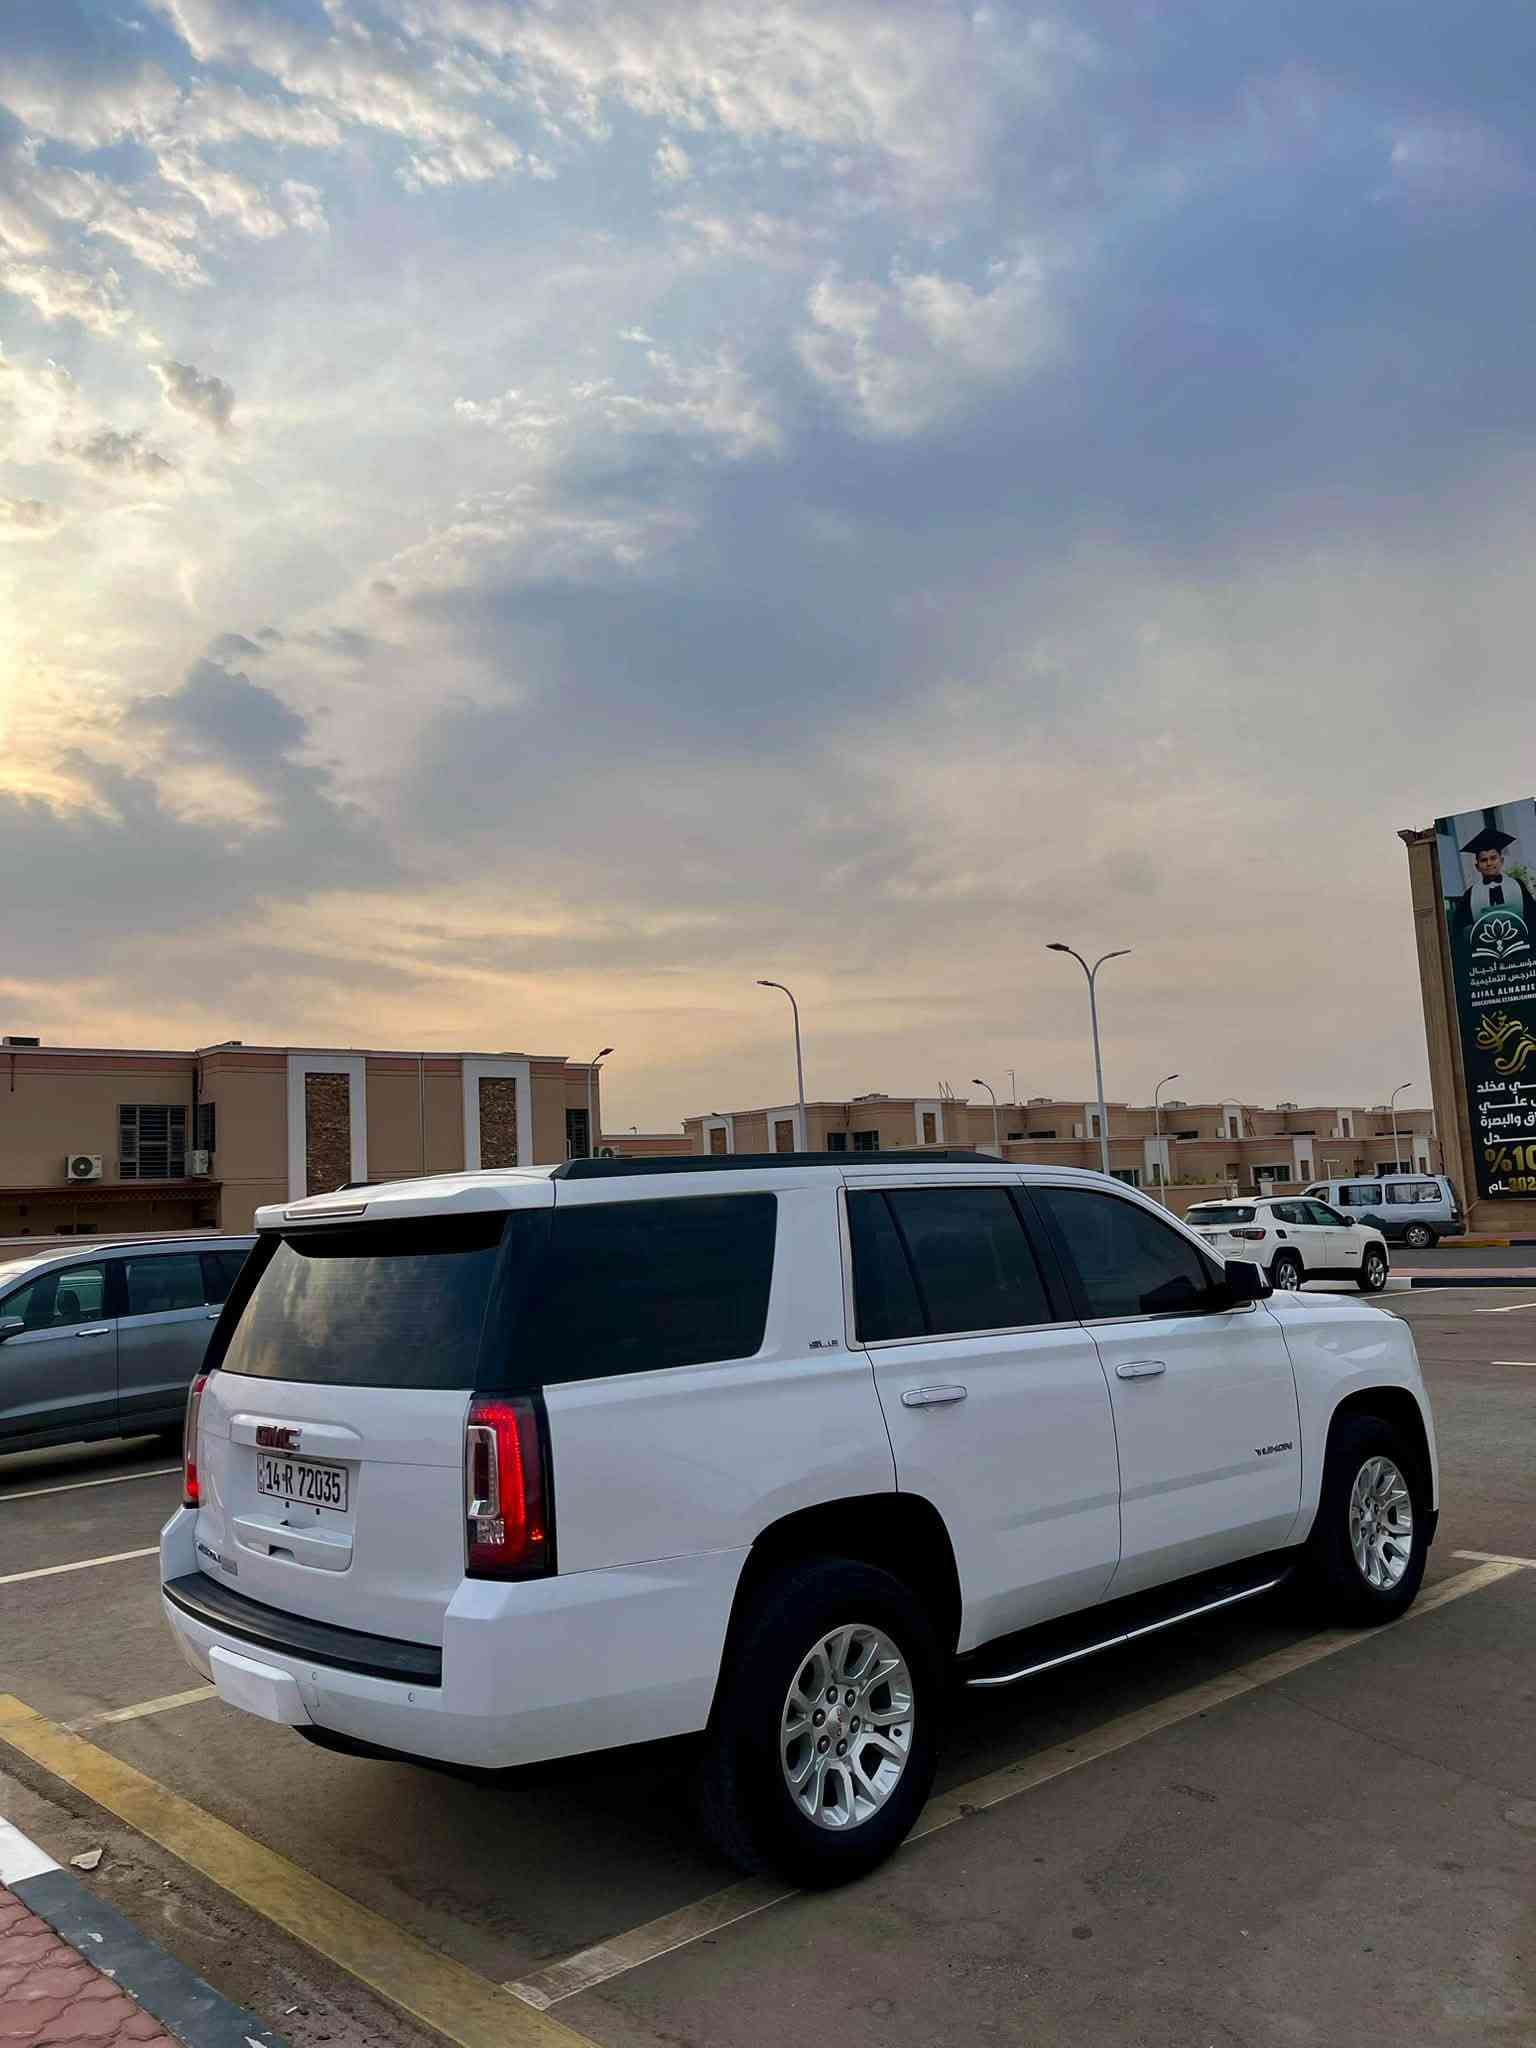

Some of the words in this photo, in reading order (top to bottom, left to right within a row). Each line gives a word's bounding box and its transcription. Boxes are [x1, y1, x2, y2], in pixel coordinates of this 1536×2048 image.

[1477, 1080, 1506, 1093] مخلد
[1480, 1113, 1521, 1129] والبصرة
[256, 1425, 303, 1451] GMC
[298, 1466, 341, 1504] 72035
